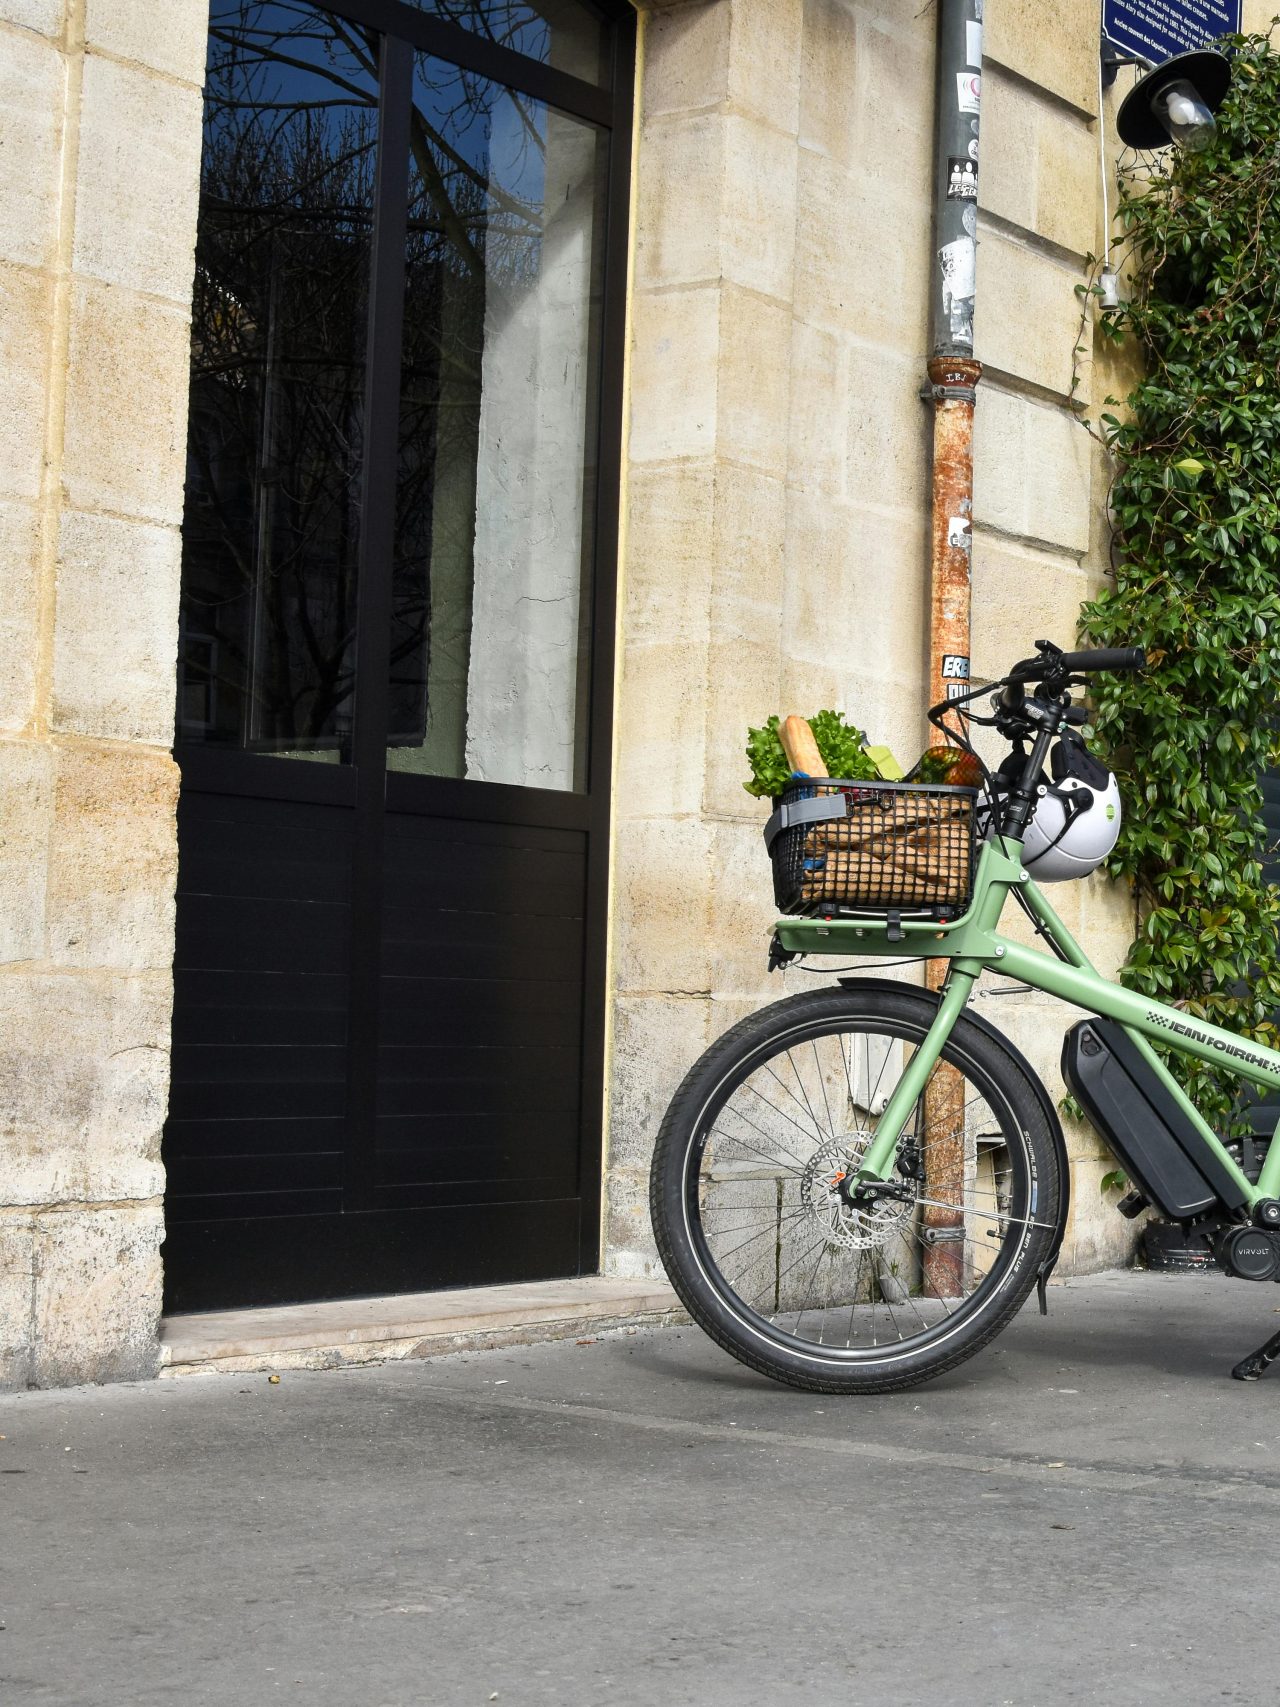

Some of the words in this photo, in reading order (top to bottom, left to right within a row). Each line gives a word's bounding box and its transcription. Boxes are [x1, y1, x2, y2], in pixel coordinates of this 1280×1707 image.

[1145, 14, 1162, 31] designed
[1183, 16, 1200, 32] designed
[1023, 1130, 1038, 1179] SCHWALBE
[1023, 1232, 1032, 1249] BEN
[1013, 1250, 1026, 1273] PLUS
